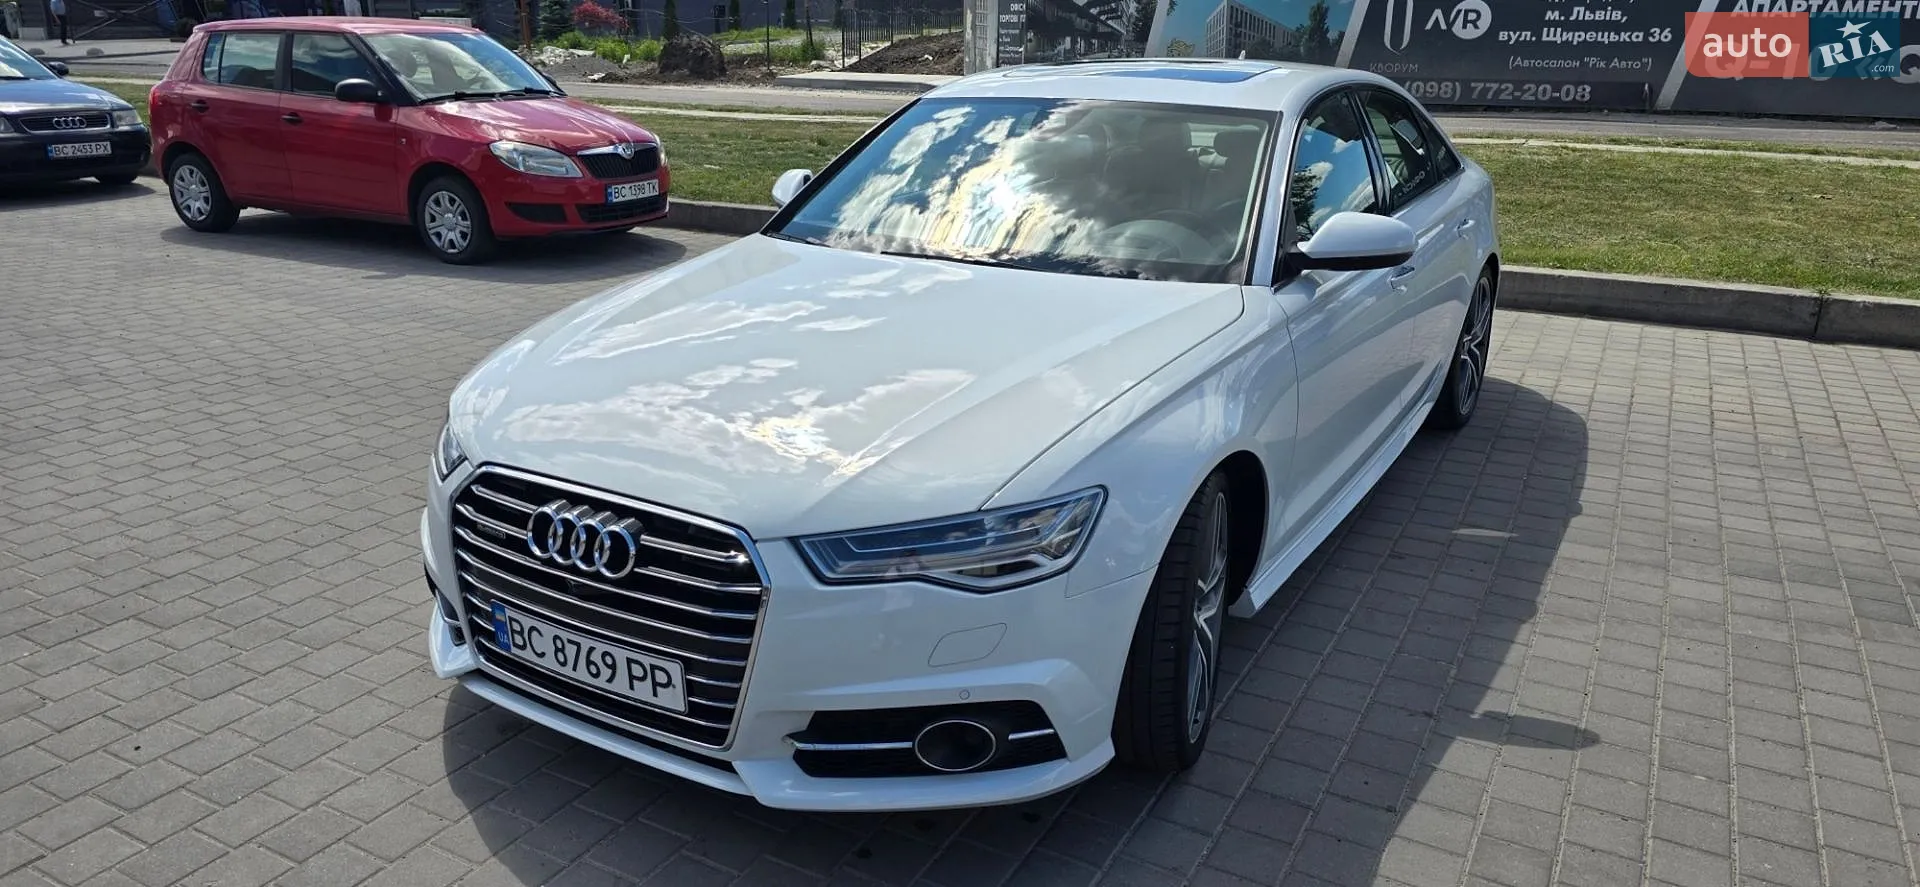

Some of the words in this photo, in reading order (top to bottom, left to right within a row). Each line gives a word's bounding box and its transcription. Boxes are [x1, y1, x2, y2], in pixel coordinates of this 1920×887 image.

[1545, 9, 1565, 21] м.
[1569, 6, 1628, 23] Львів,
[1498, 31, 1536, 45] вул.
[1541, 27, 1644, 45] Щирецька
[1648, 27, 1672, 42] 36
[1369, 62, 1419, 73] КВОРУМ
[1508, 55, 1580, 70] (Автосалон
[1608, 57, 1652, 72] Авто")
[613, 186, 626, 199] BC
[498, 631, 509, 643] UA
[507, 615, 546, 659] BC
[552, 634, 617, 684] 8769
[626, 656, 673, 698] PP
